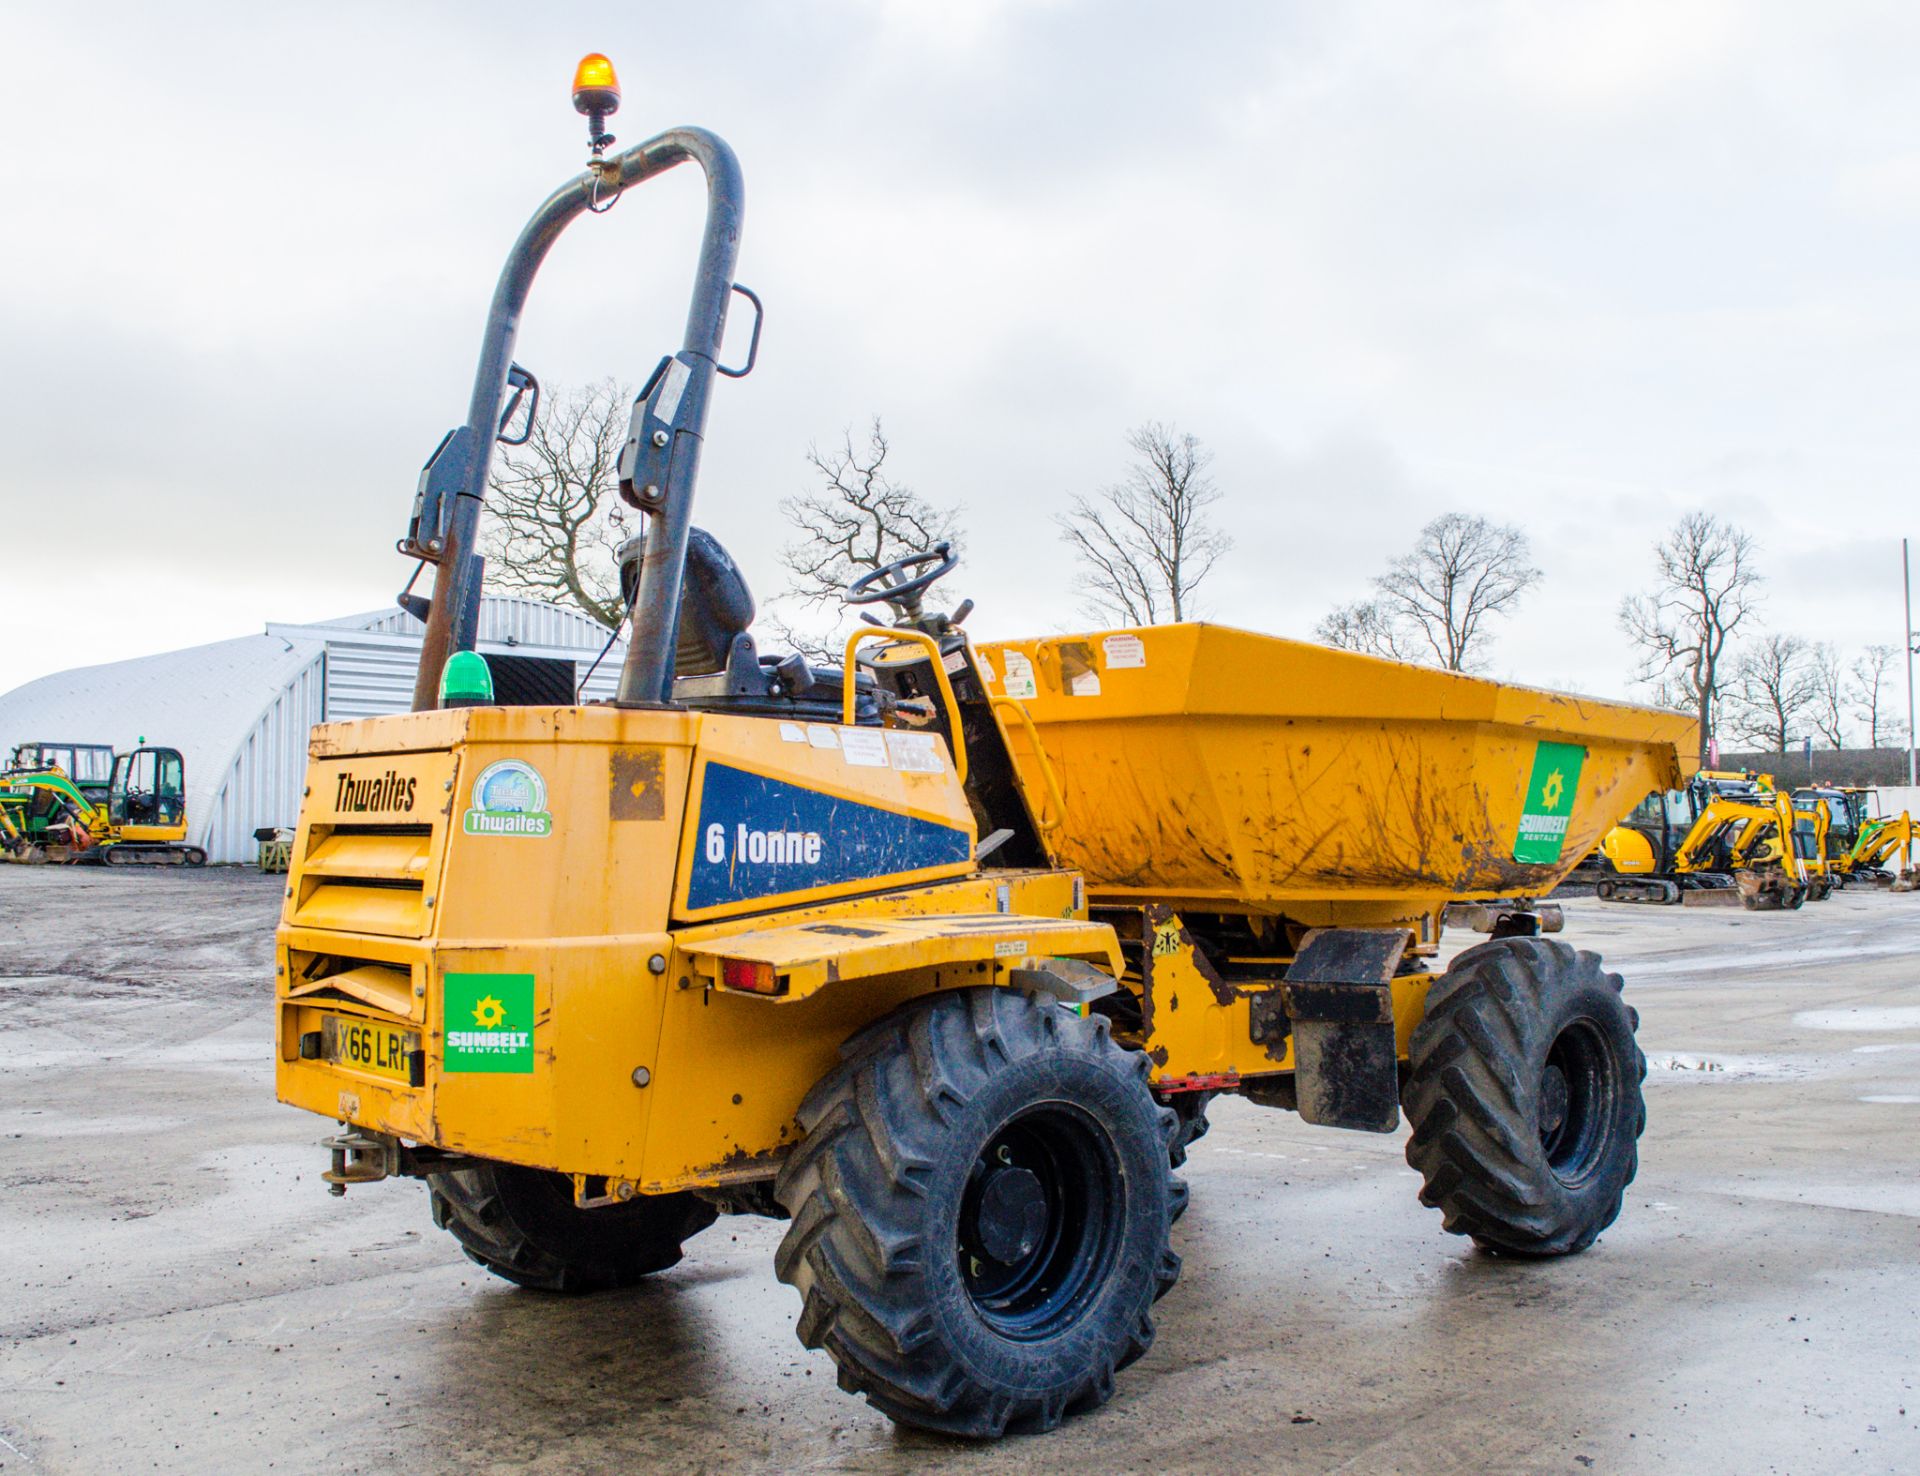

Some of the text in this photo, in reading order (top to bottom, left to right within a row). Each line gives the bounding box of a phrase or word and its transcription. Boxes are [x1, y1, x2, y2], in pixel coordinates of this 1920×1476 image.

[335, 770, 417, 812] Thwaites
[471, 812, 546, 833] Thwaites
[706, 823, 821, 864] 6 tonne
[447, 1031, 529, 1048] SUNBELT
